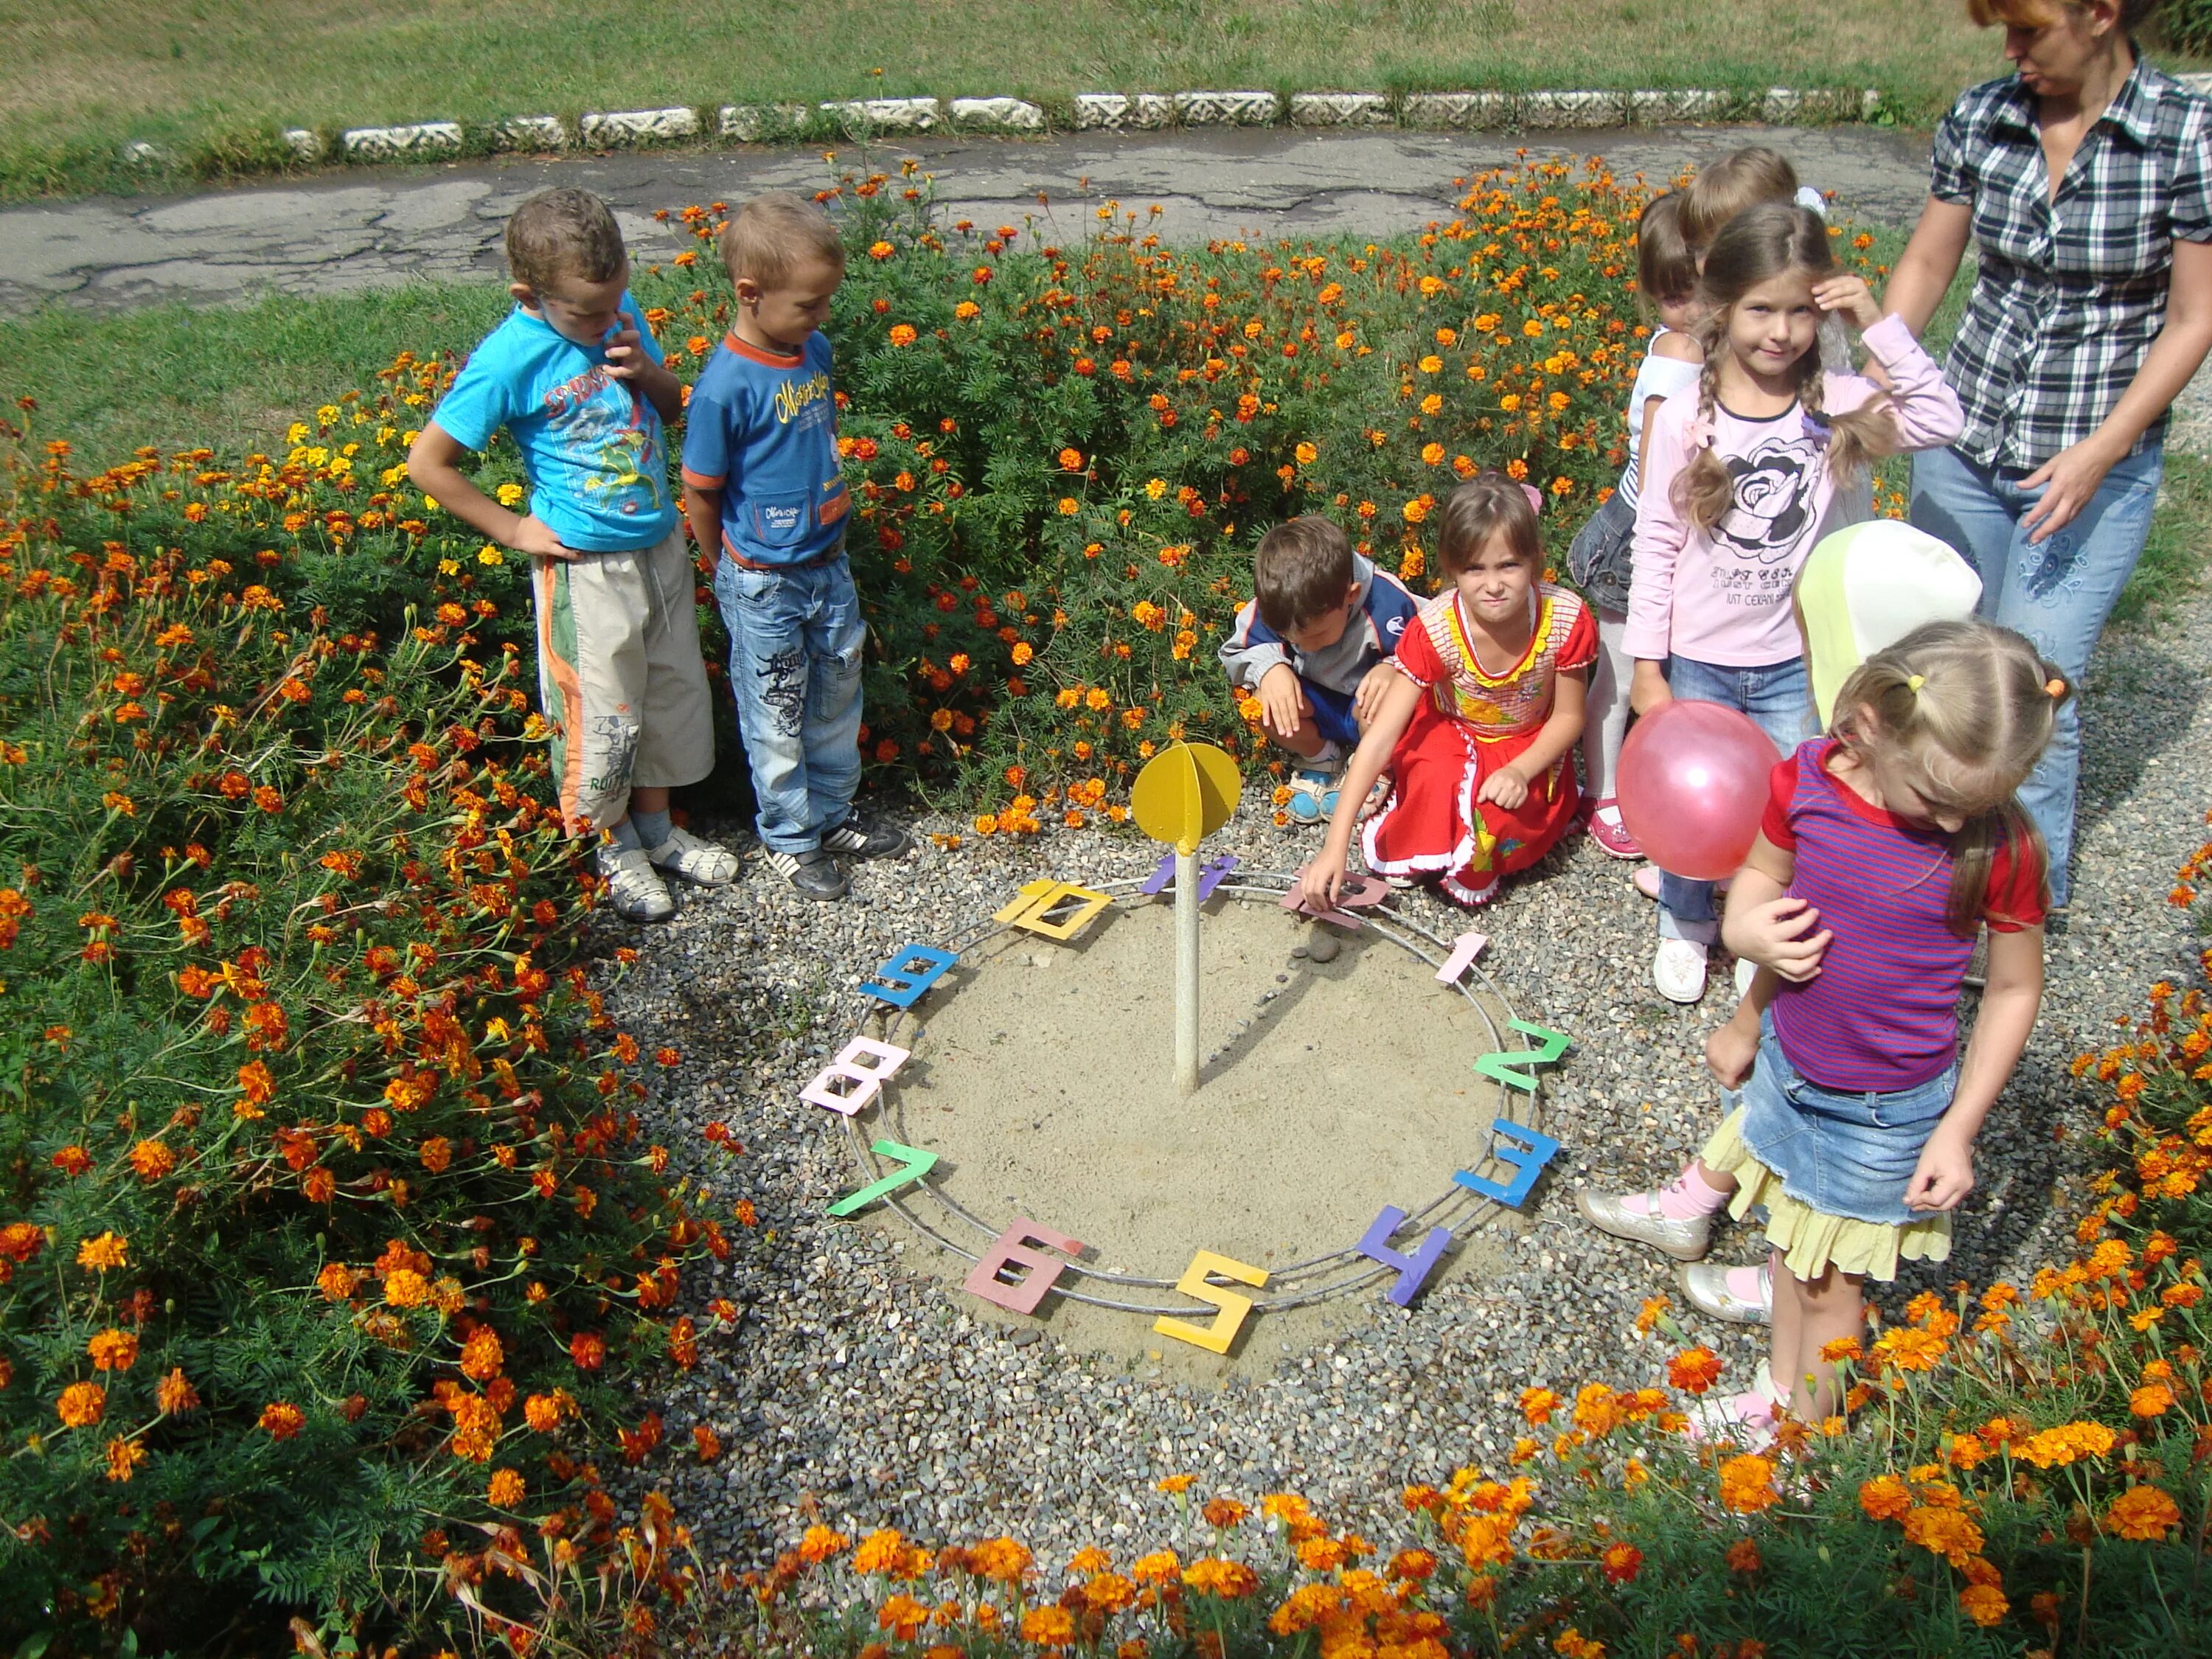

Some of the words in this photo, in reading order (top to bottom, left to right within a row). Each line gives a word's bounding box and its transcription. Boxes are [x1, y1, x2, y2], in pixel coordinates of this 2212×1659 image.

[992, 878, 1114, 940] 10
[859, 943, 959, 1007] 9
[1434, 931, 1489, 984] 1
[799, 1034, 911, 1116] 8
[1473, 1018, 1572, 1091] 2
[825, 1139, 939, 1217] 7
[1453, 1118, 1561, 1207] 3
[963, 1217, 1085, 1315] 6
[1355, 1206, 1453, 1307] 4
[1152, 1250, 1270, 1354] 5
